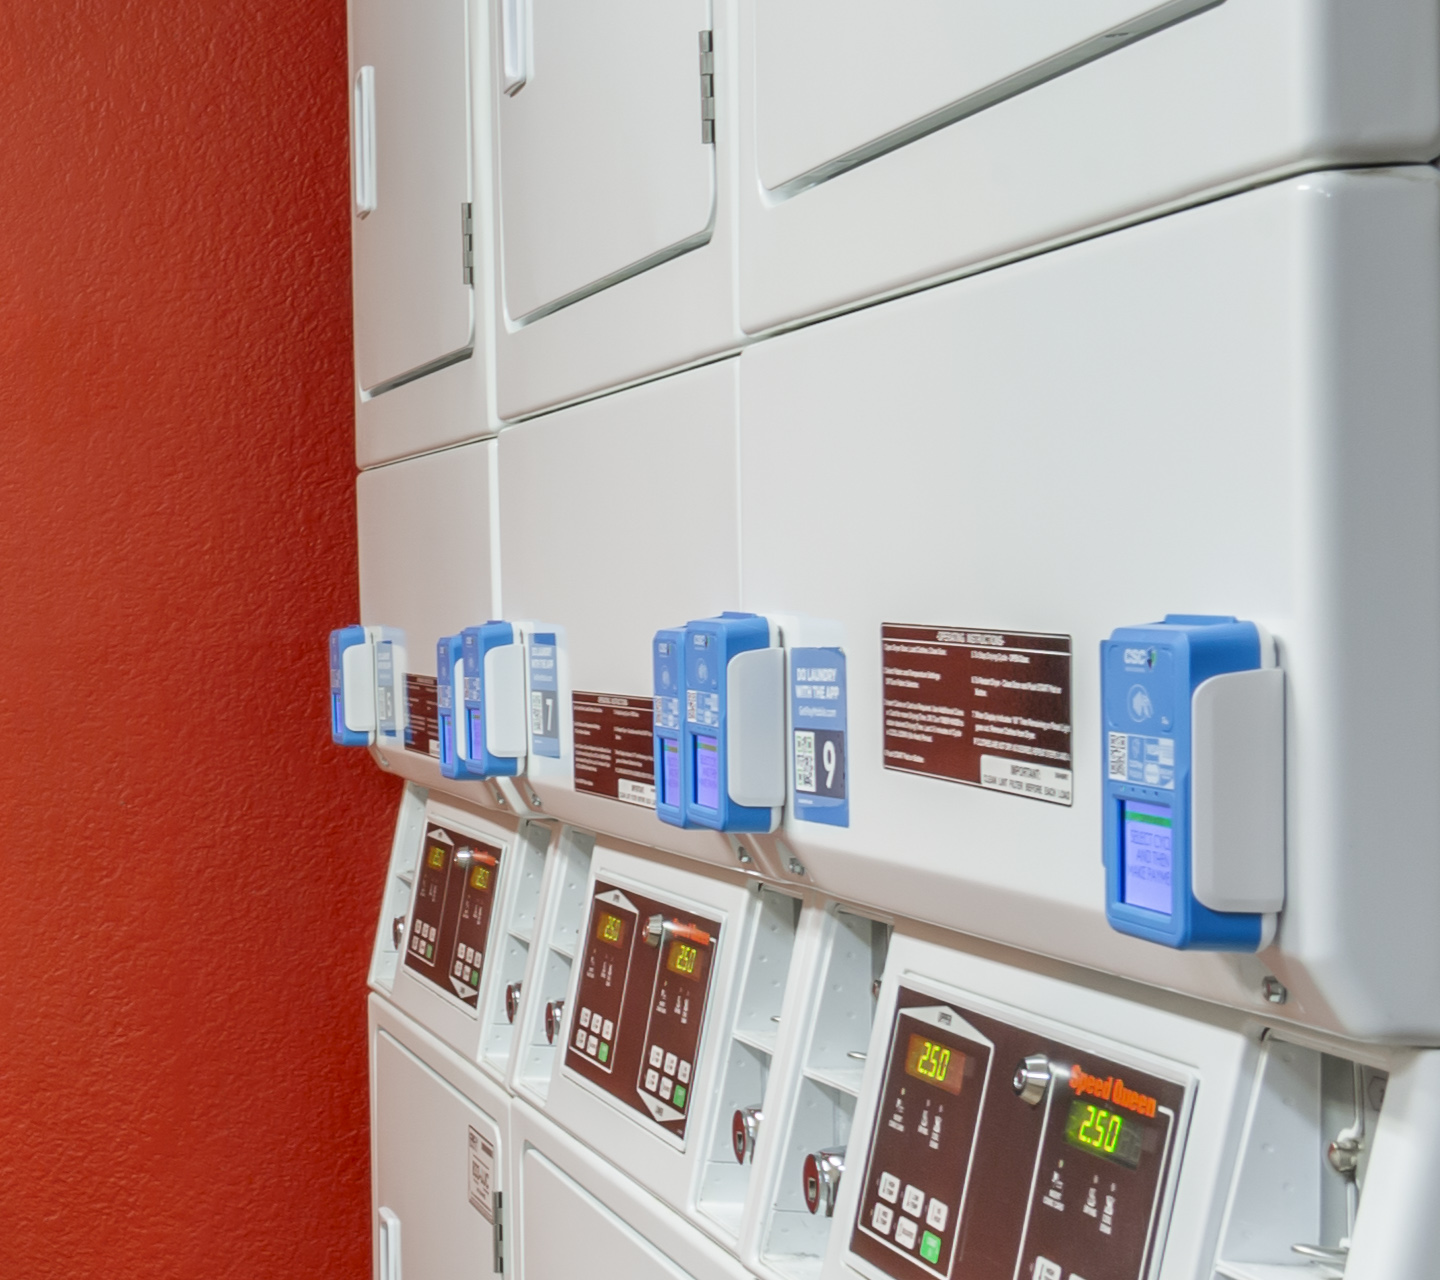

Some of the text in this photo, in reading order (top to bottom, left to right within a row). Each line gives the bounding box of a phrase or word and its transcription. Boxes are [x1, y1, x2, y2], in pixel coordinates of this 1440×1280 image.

[796, 667, 837, 682] DO LAUNDRY
[1124, 649, 1147, 665] CSC
[795, 685, 840, 700] WITH THE APP
[823, 740, 836, 789] 9
[917, 1041, 951, 1082] 2.50
[1069, 1064, 1157, 1119] Speed Queen
[1078, 1105, 1123, 1154] 2.50
